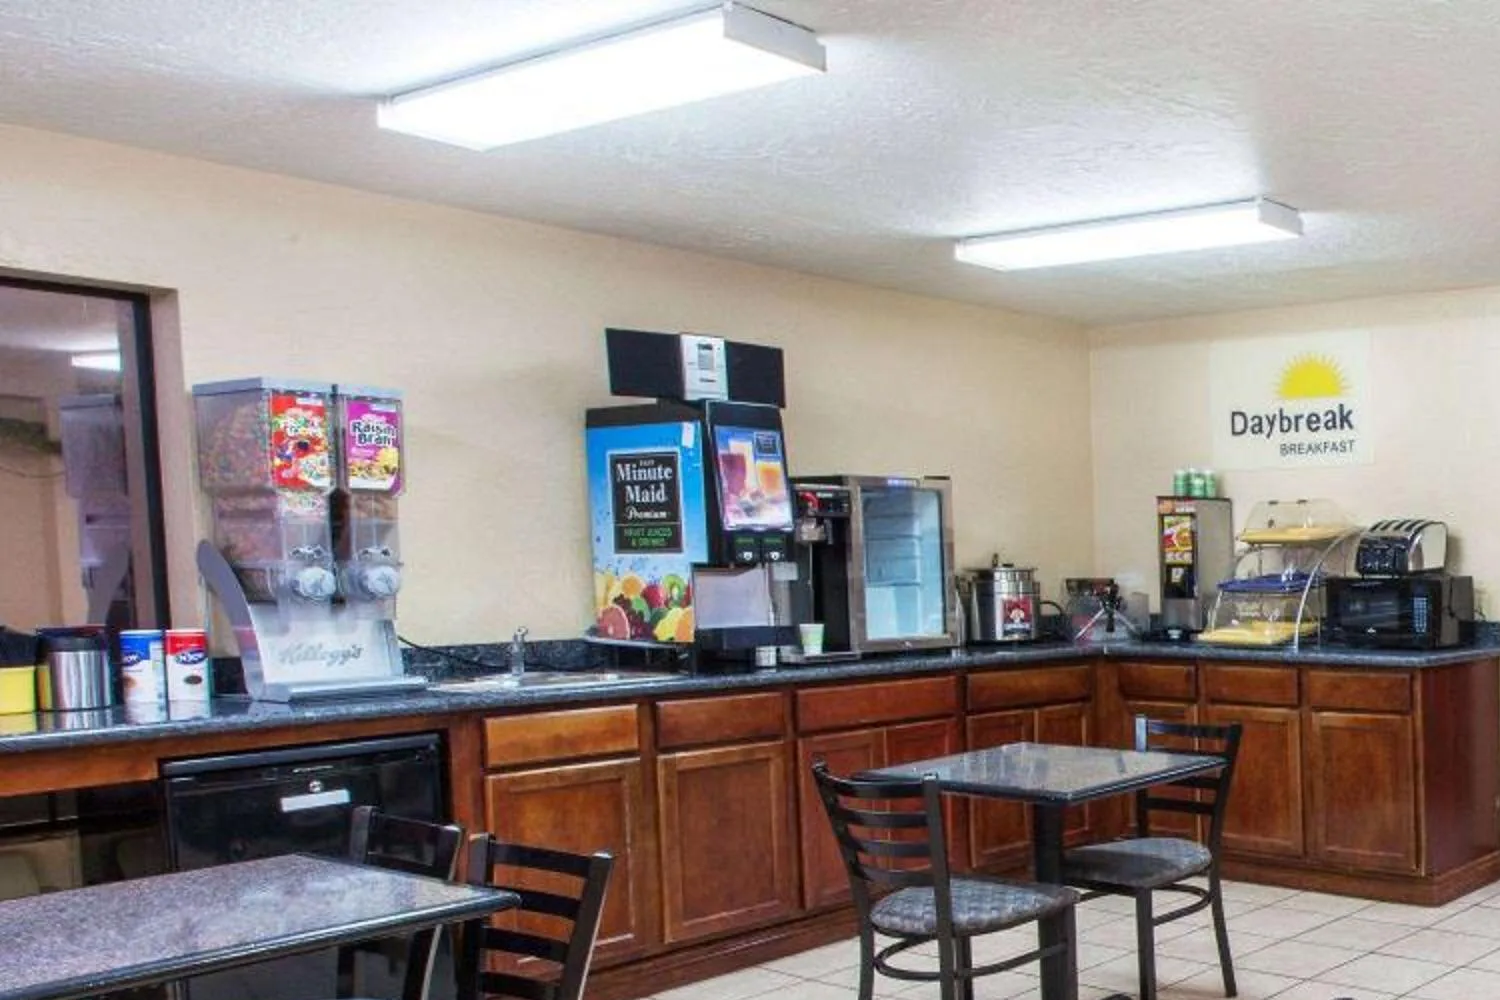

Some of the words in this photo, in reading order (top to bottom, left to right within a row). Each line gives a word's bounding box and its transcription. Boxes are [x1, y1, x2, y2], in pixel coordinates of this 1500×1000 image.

[351, 419, 397, 436] Raisin
[1231, 403, 1354, 439] Daybreak
[357, 431, 391, 446] Bran
[1280, 440, 1355, 456] BREAKFAST
[616, 463, 673, 481] Minute
[625, 482, 667, 503] Maid
[624, 505, 668, 520] Premium
[279, 641, 364, 667] Kellogg's
